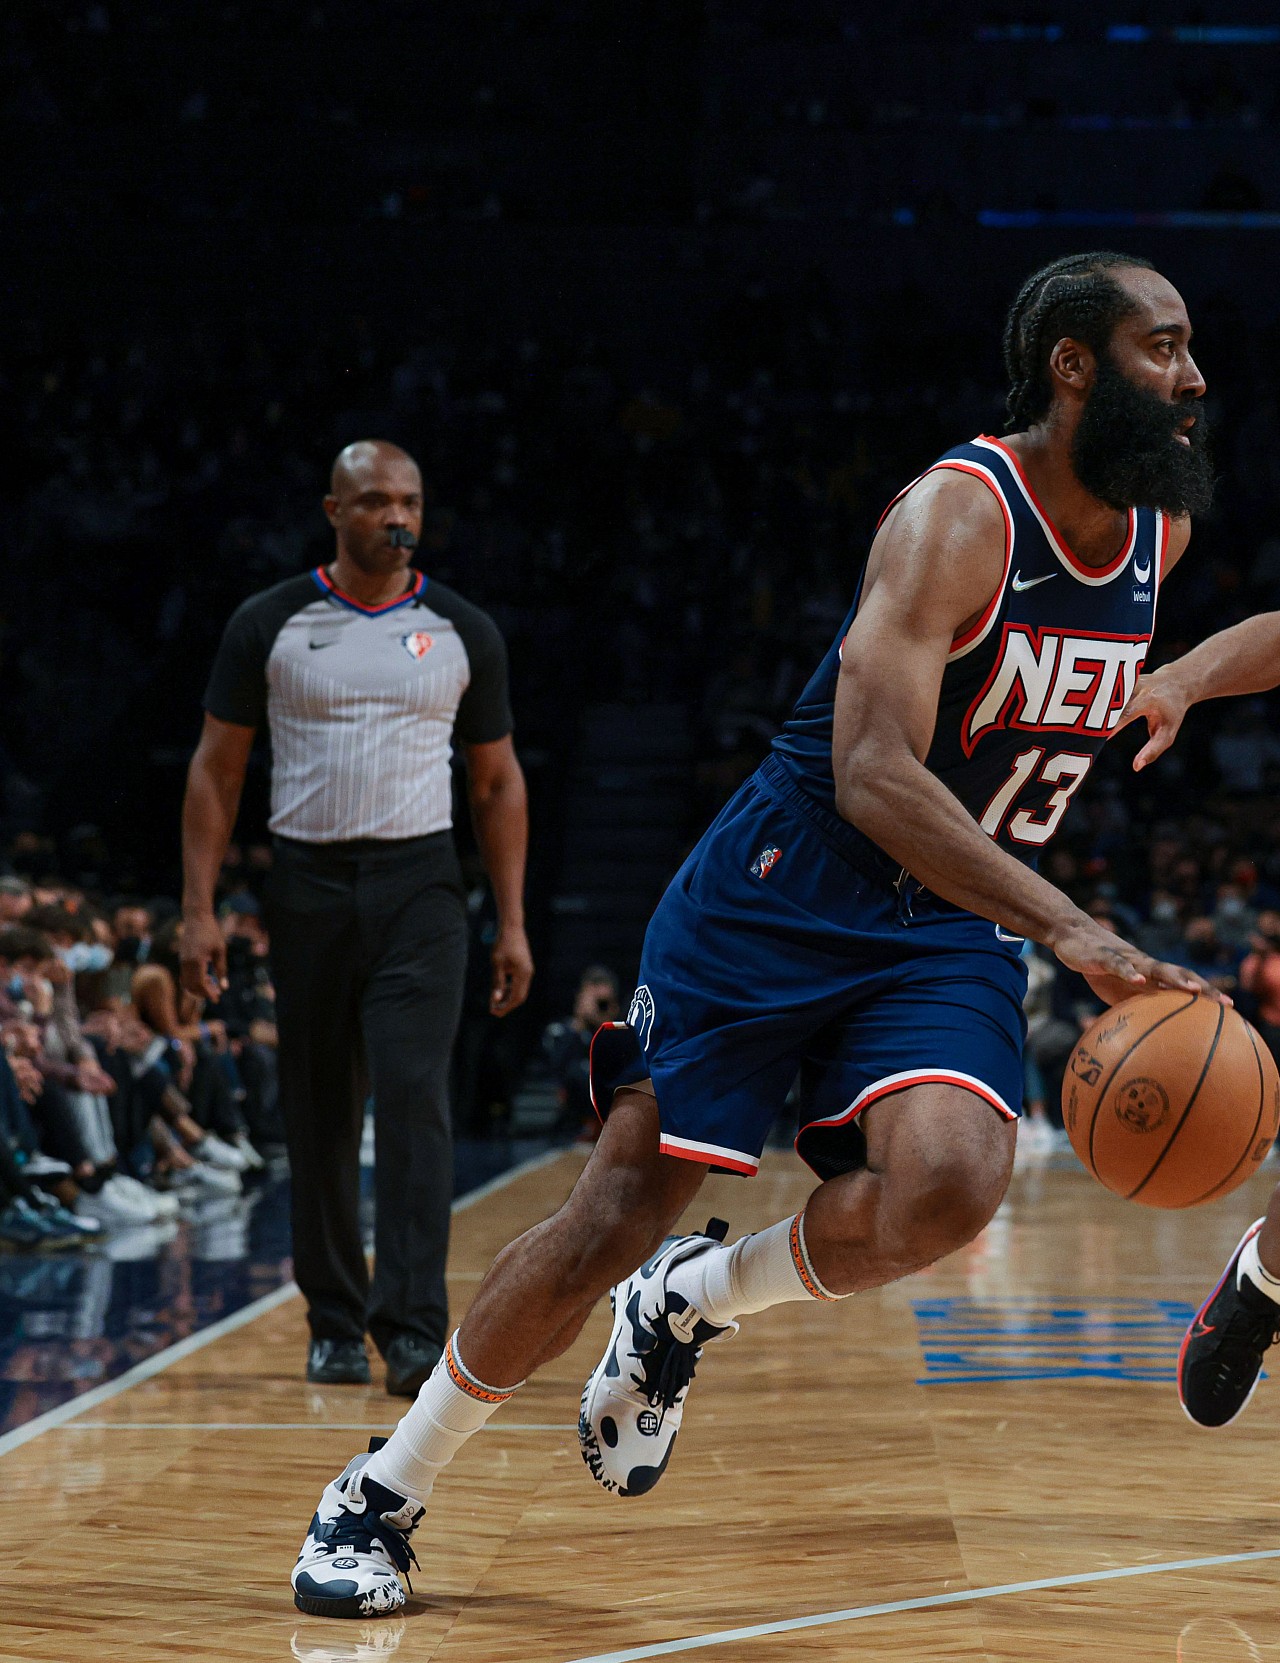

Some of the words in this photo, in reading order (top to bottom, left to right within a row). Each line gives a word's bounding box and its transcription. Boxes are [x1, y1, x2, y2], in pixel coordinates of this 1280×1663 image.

[1133, 590, 1151, 603] Webull
[966, 627, 1150, 748] NETS
[979, 746, 1093, 846] 13
